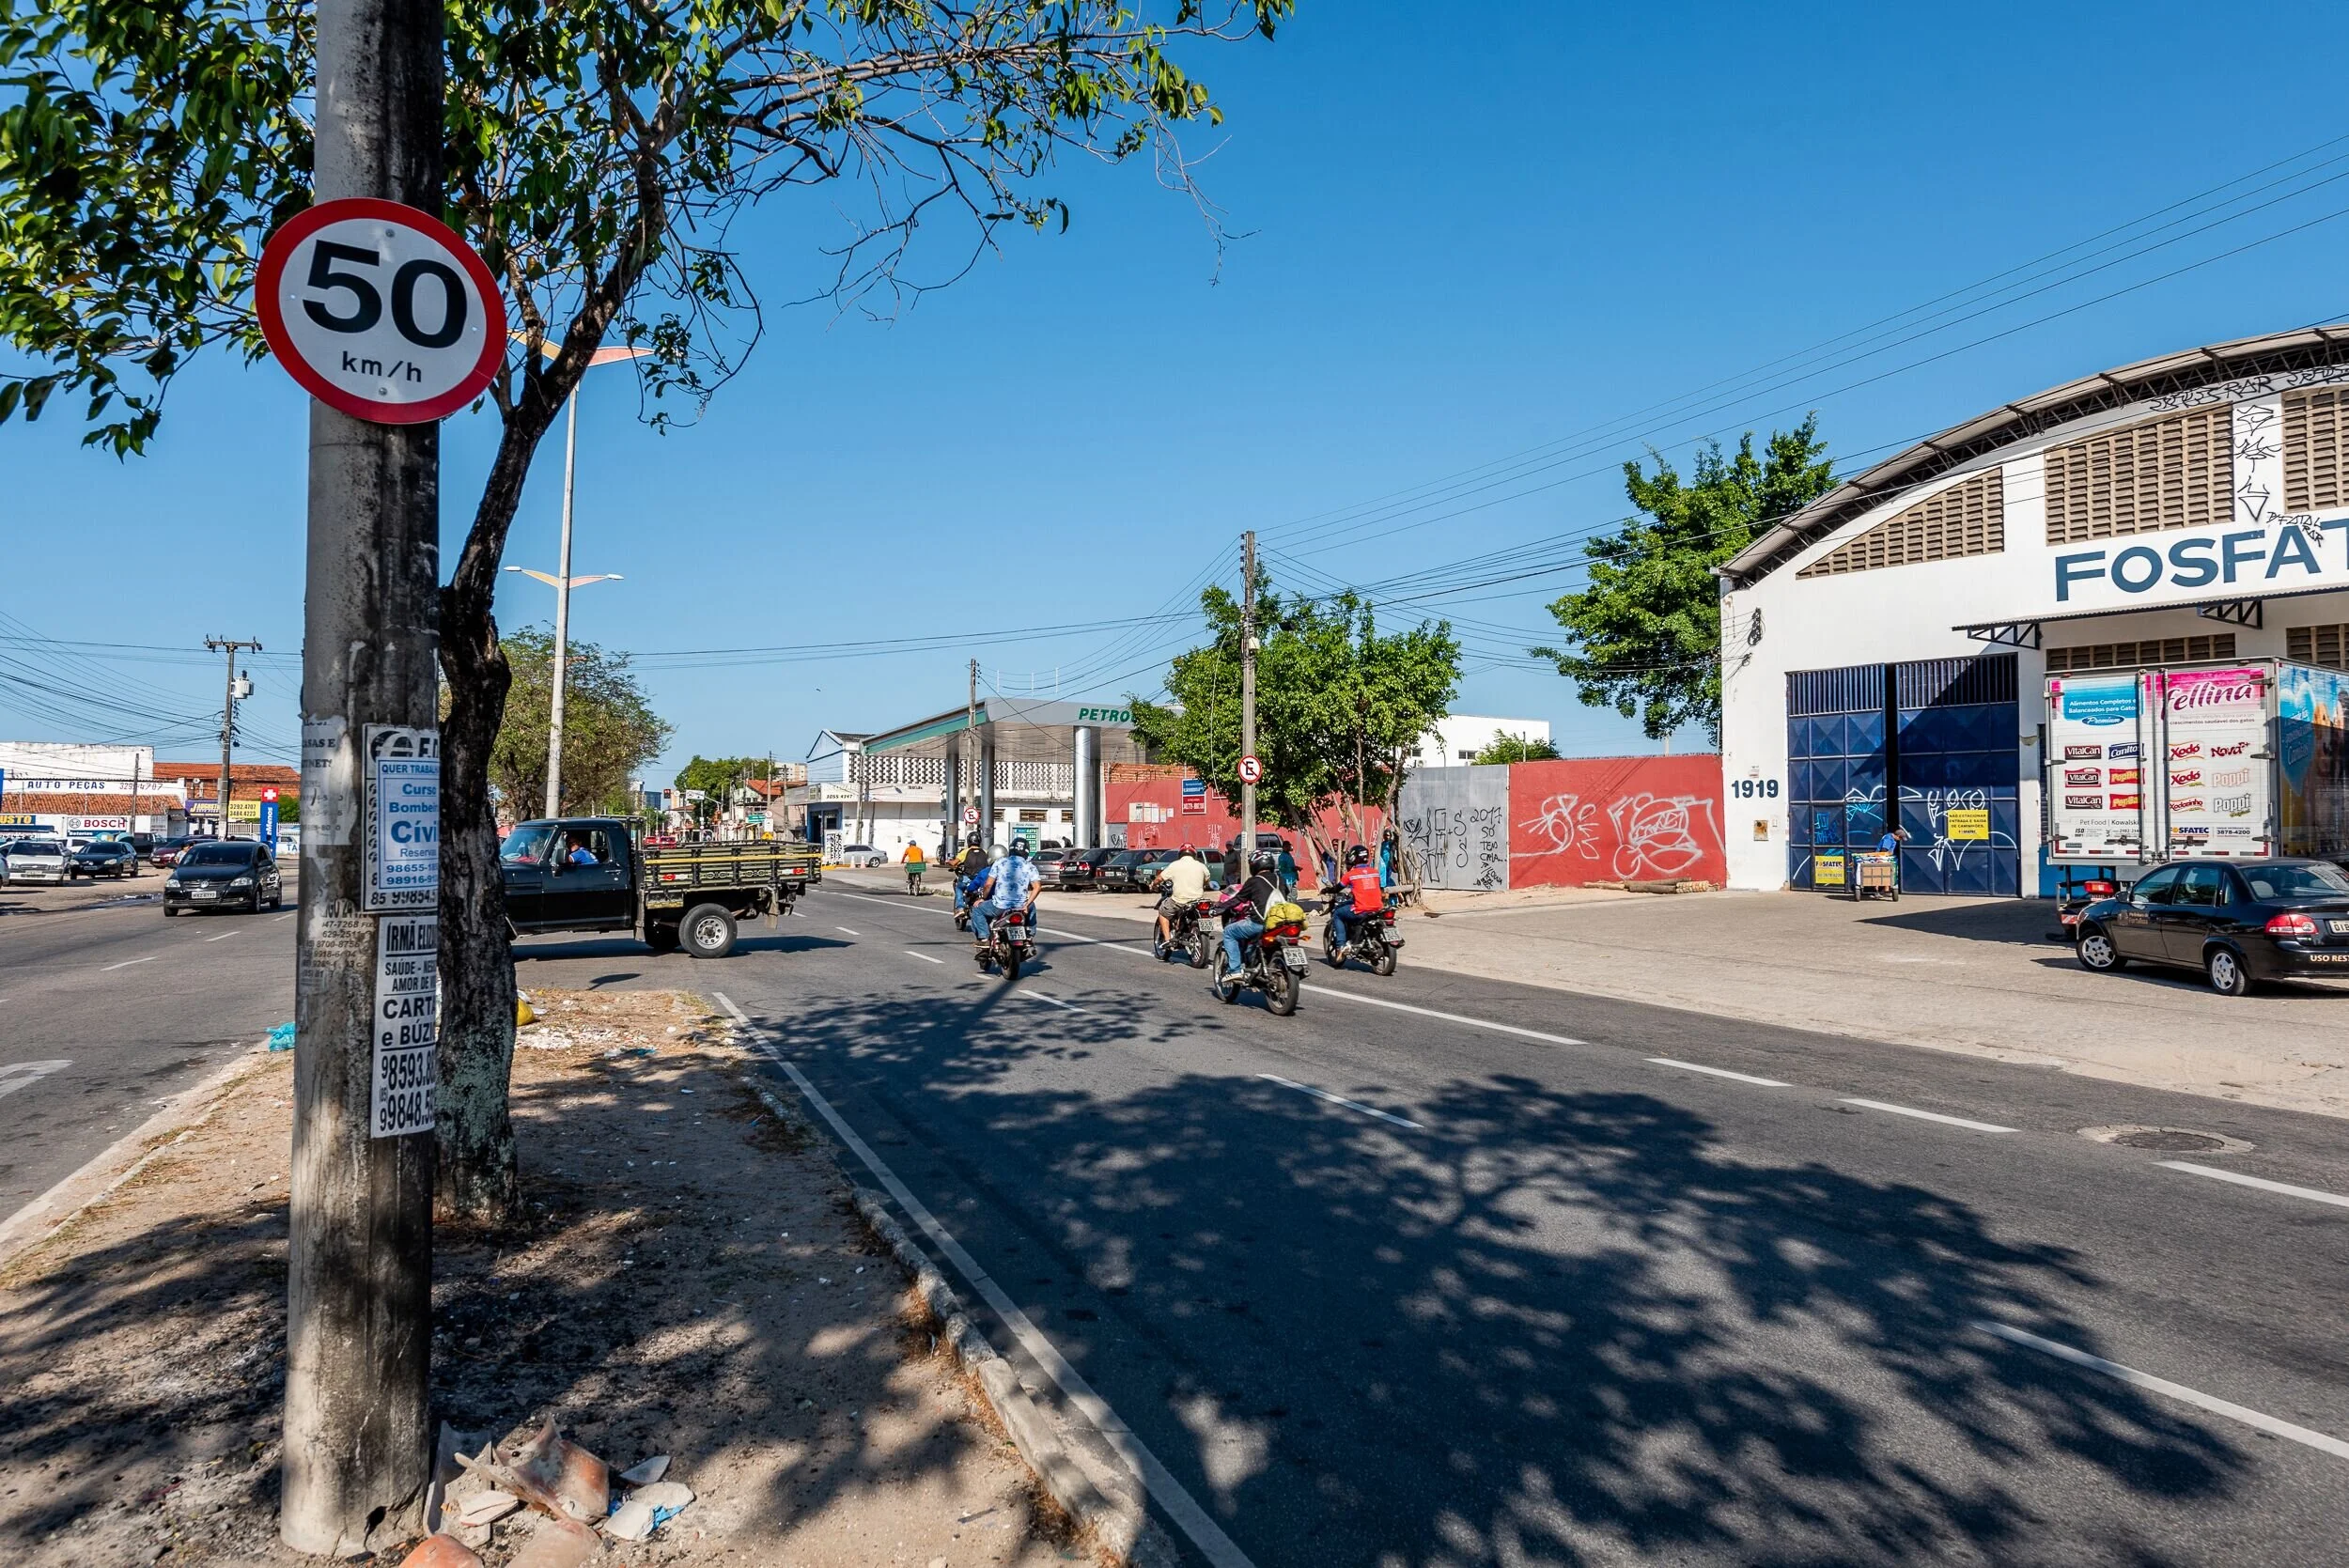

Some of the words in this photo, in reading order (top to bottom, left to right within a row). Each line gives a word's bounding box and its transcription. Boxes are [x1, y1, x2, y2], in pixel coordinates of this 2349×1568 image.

[302, 239, 468, 349] 50
[341, 350, 423, 383] km/h
[2100, 697, 2132, 707] Completos
[1078, 707, 1136, 722] PETRO
[2085, 715, 2121, 723] Premium
[2066, 746, 2101, 755] VitalCan
[2110, 745, 2138, 758] Canito
[2170, 743, 2201, 758] Xodó
[381, 764, 408, 773] QUER
[2170, 770, 2201, 785] Xodó
[2212, 768, 2249, 788] Poppi
[27, 781, 61, 789] AUTO
[69, 781, 105, 790] PEÇAS
[119, 782, 163, 791] 329-4707
[1731, 779, 1779, 800] 1919
[2067, 796, 2102, 804] VitalCan
[2213, 793, 2251, 813] Poppi
[1470, 806, 1503, 825] 2017
[84, 819, 126, 828] BOSCH
[370, 892, 386, 905] 85
[384, 958, 416, 976] SAÚDE
[392, 977, 419, 992] AMOR
[420, 976, 429, 990] DE
[381, 1031, 394, 1047] e
